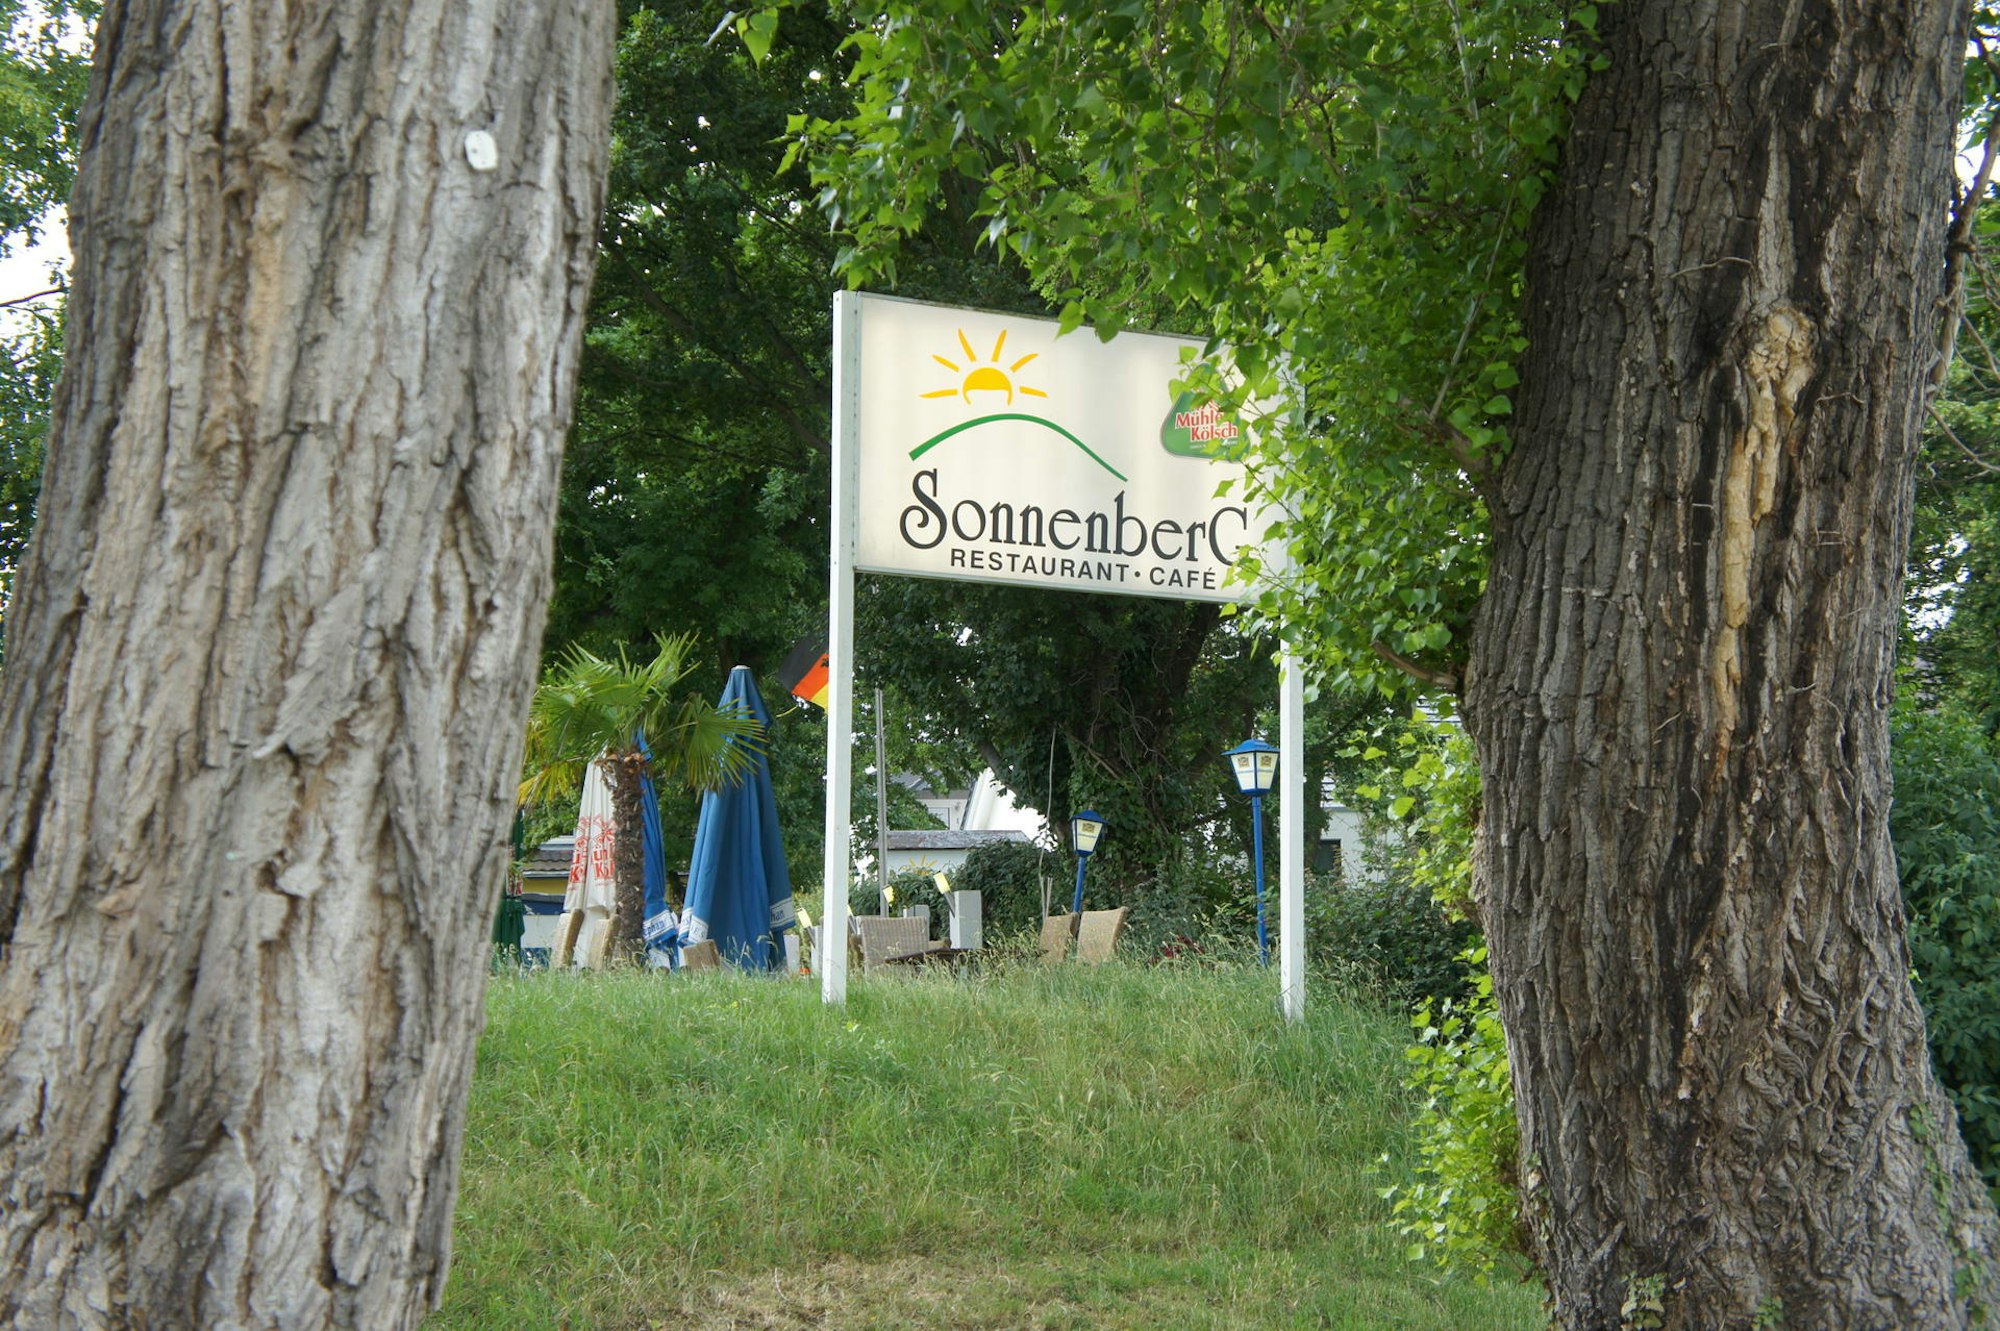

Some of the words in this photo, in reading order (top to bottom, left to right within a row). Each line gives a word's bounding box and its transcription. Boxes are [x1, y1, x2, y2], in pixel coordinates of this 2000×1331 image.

[1190, 421, 1239, 442] Kölsch
[950, 548, 1130, 583] RESTAURANT
[1149, 567, 1217, 591] CAFÉ
